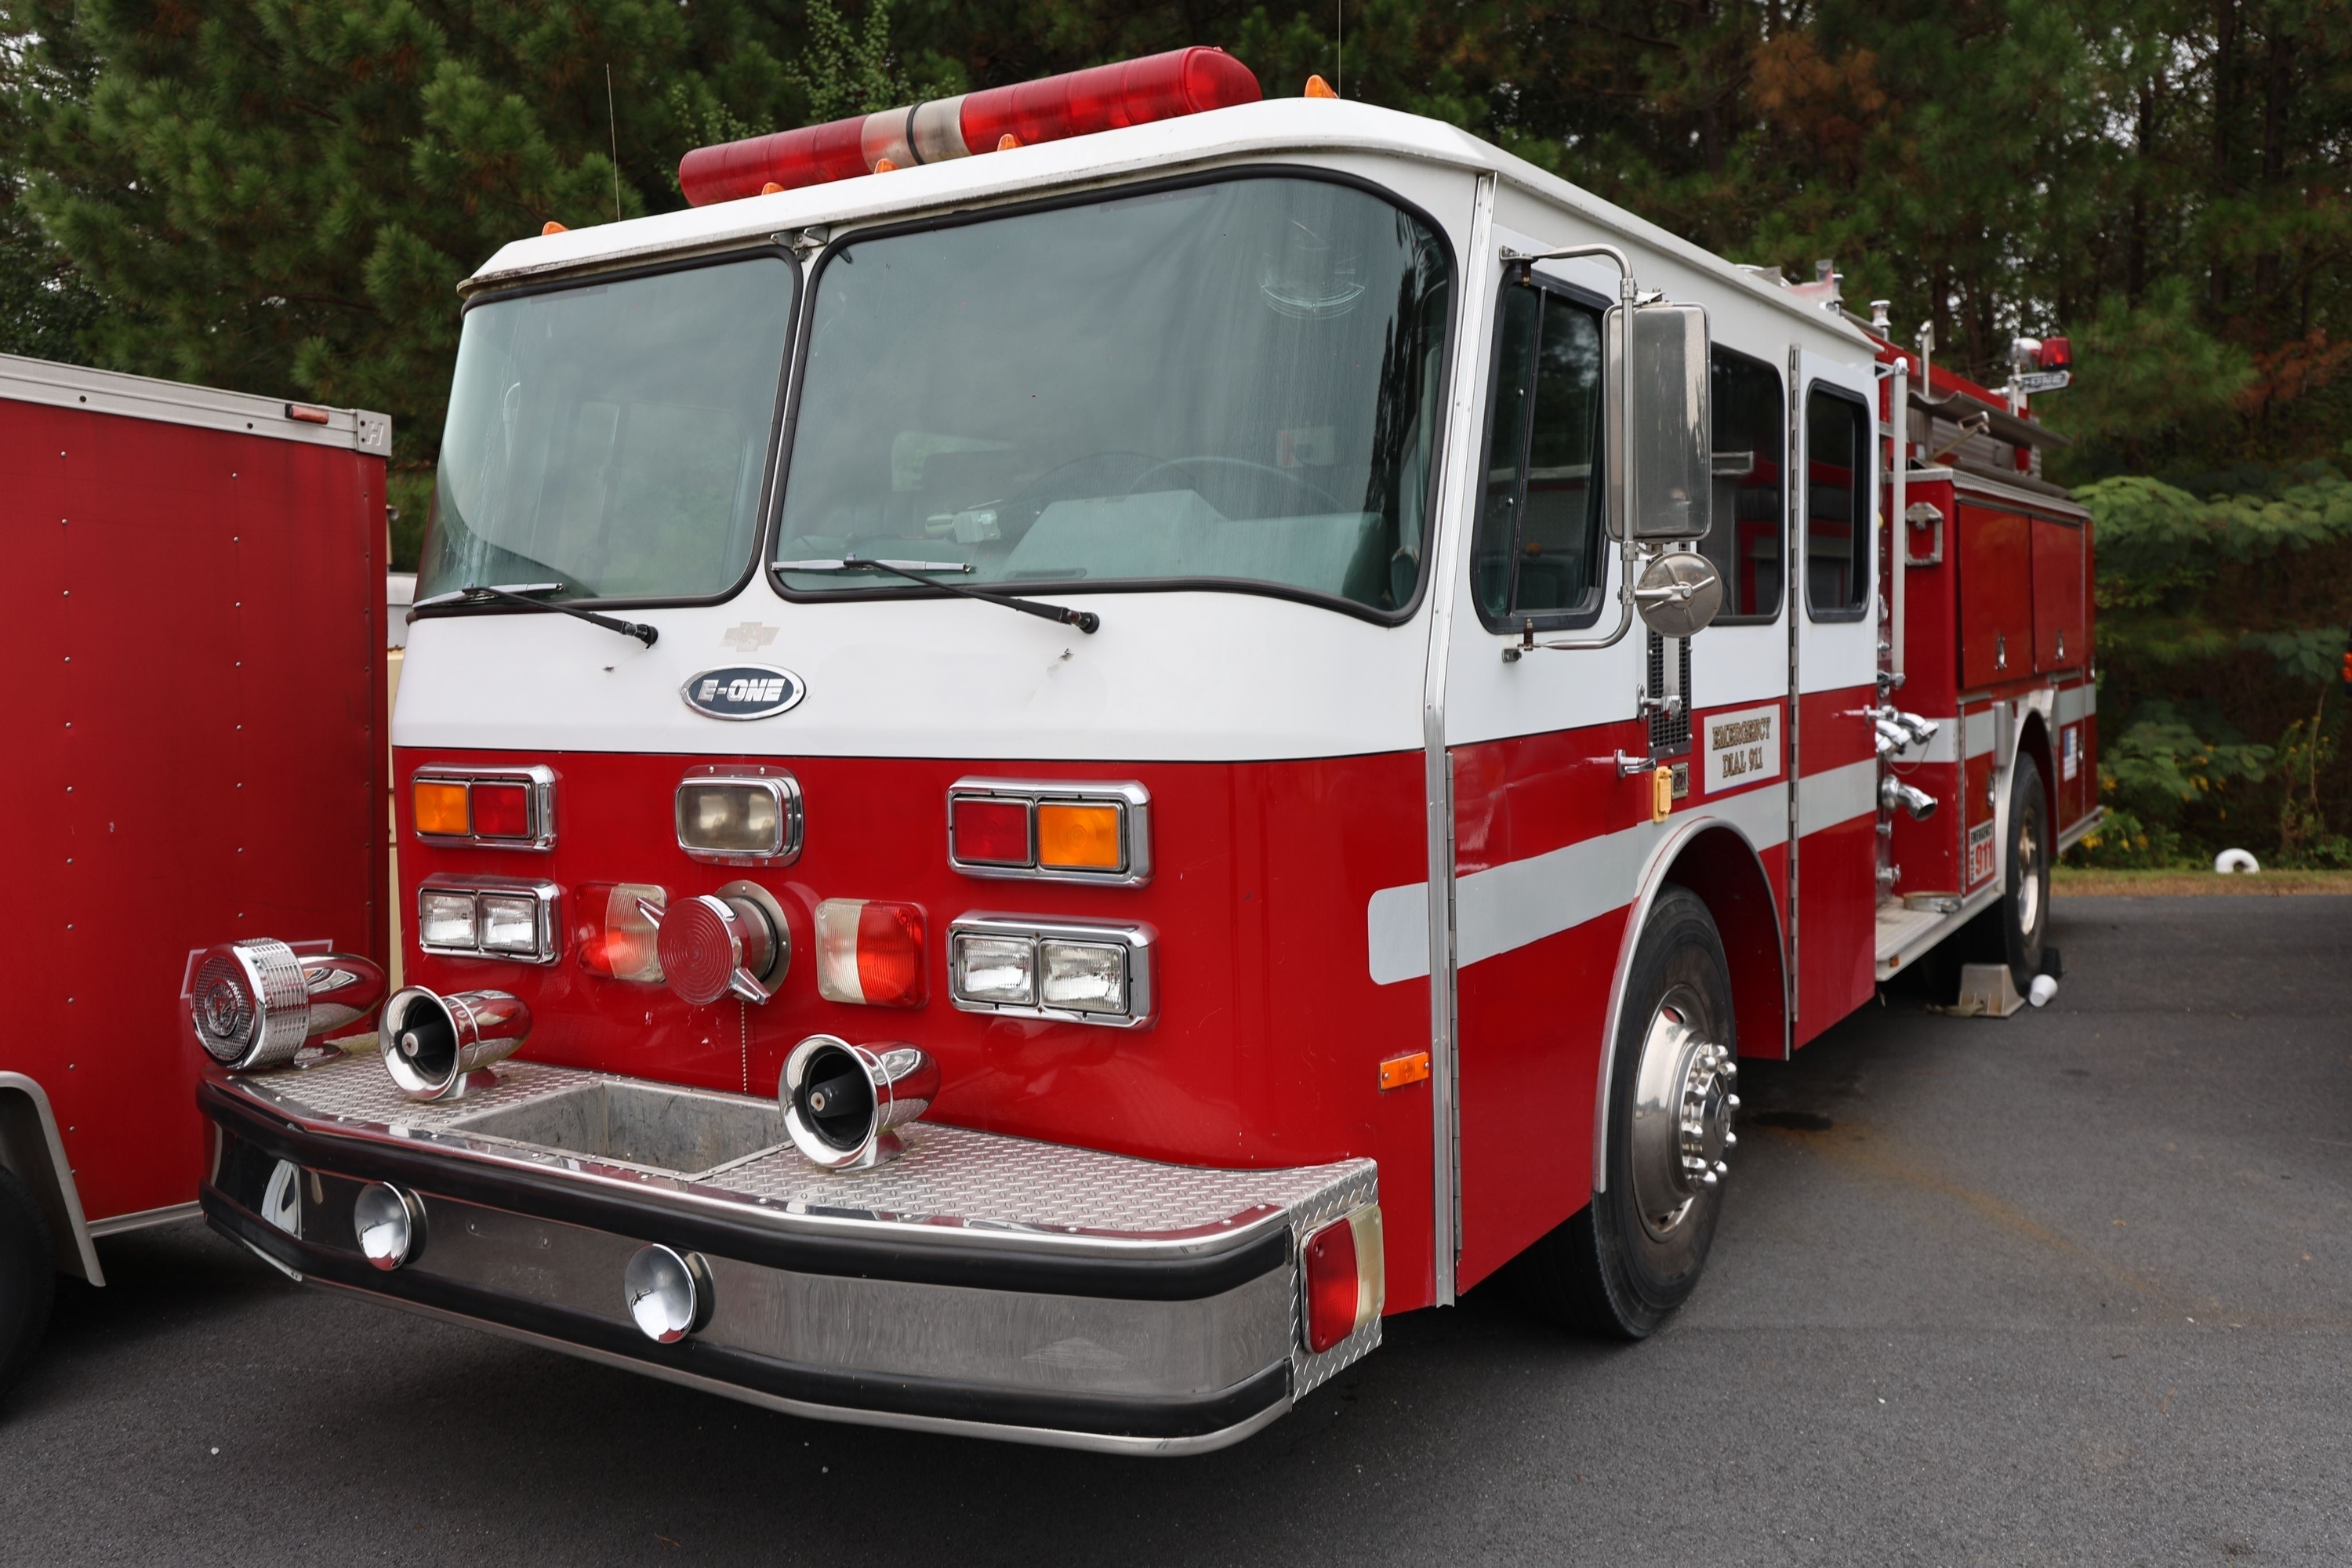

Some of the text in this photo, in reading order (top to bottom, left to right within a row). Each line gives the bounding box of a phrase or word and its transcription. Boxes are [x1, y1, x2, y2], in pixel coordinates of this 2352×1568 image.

[2020, 374, 2063, 387] -ONE
[696, 678, 786, 702] E-ONE
[1712, 717, 1771, 750] EMERGENCY
[1722, 746, 1763, 779] DIAL 911
[1970, 822, 1993, 846] EMERGENCY
[1975, 838, 1993, 876] 911
